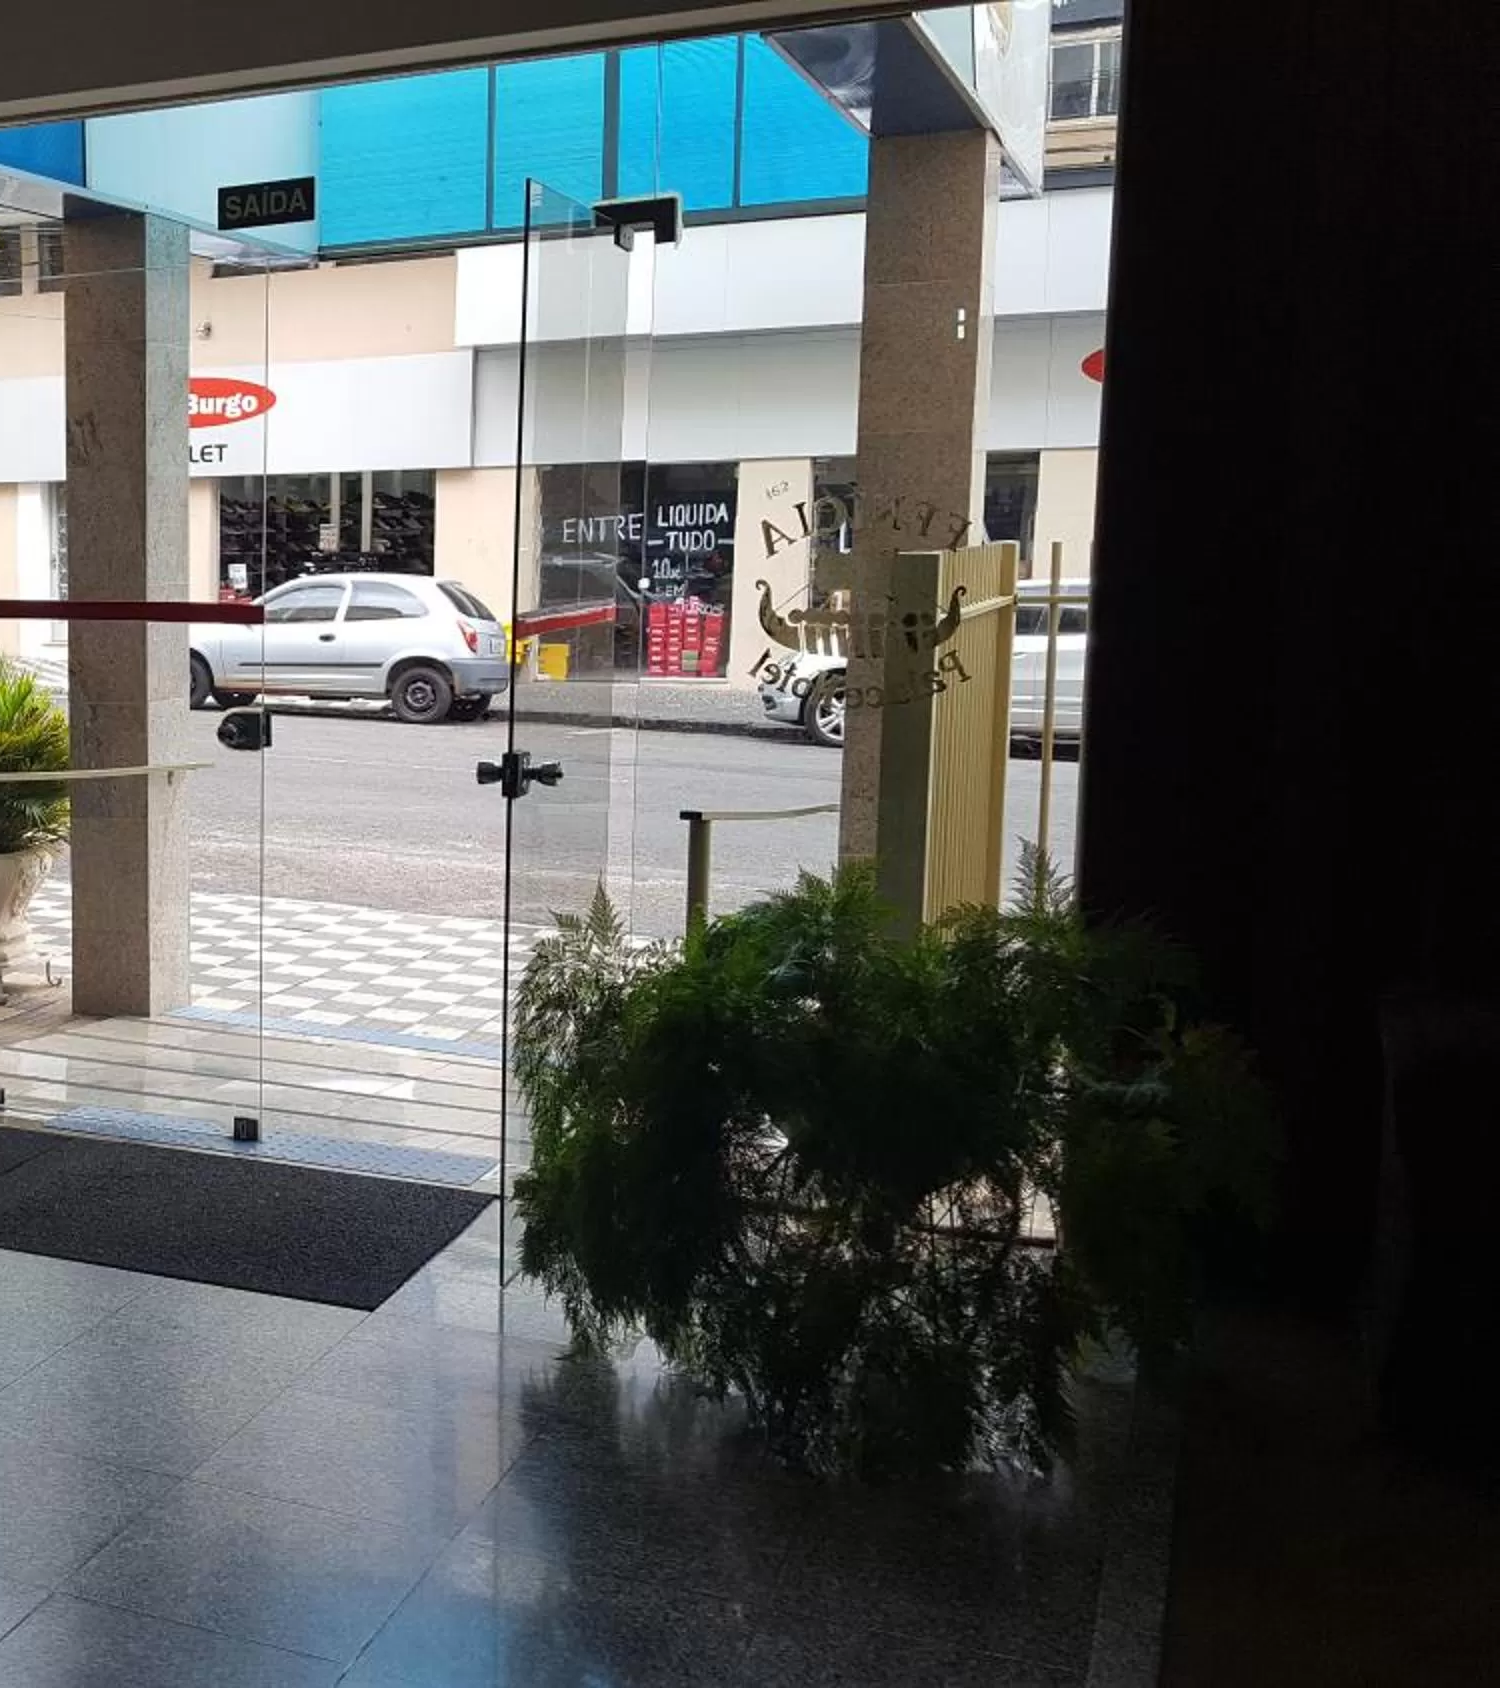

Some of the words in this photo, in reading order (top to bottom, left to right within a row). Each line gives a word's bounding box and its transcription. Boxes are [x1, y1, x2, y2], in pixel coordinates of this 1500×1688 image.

[187, 393, 258, 418] Burgo
[189, 444, 228, 463] LET
[657, 502, 729, 527] LIQUIDA
[563, 513, 645, 543] ENTRE
